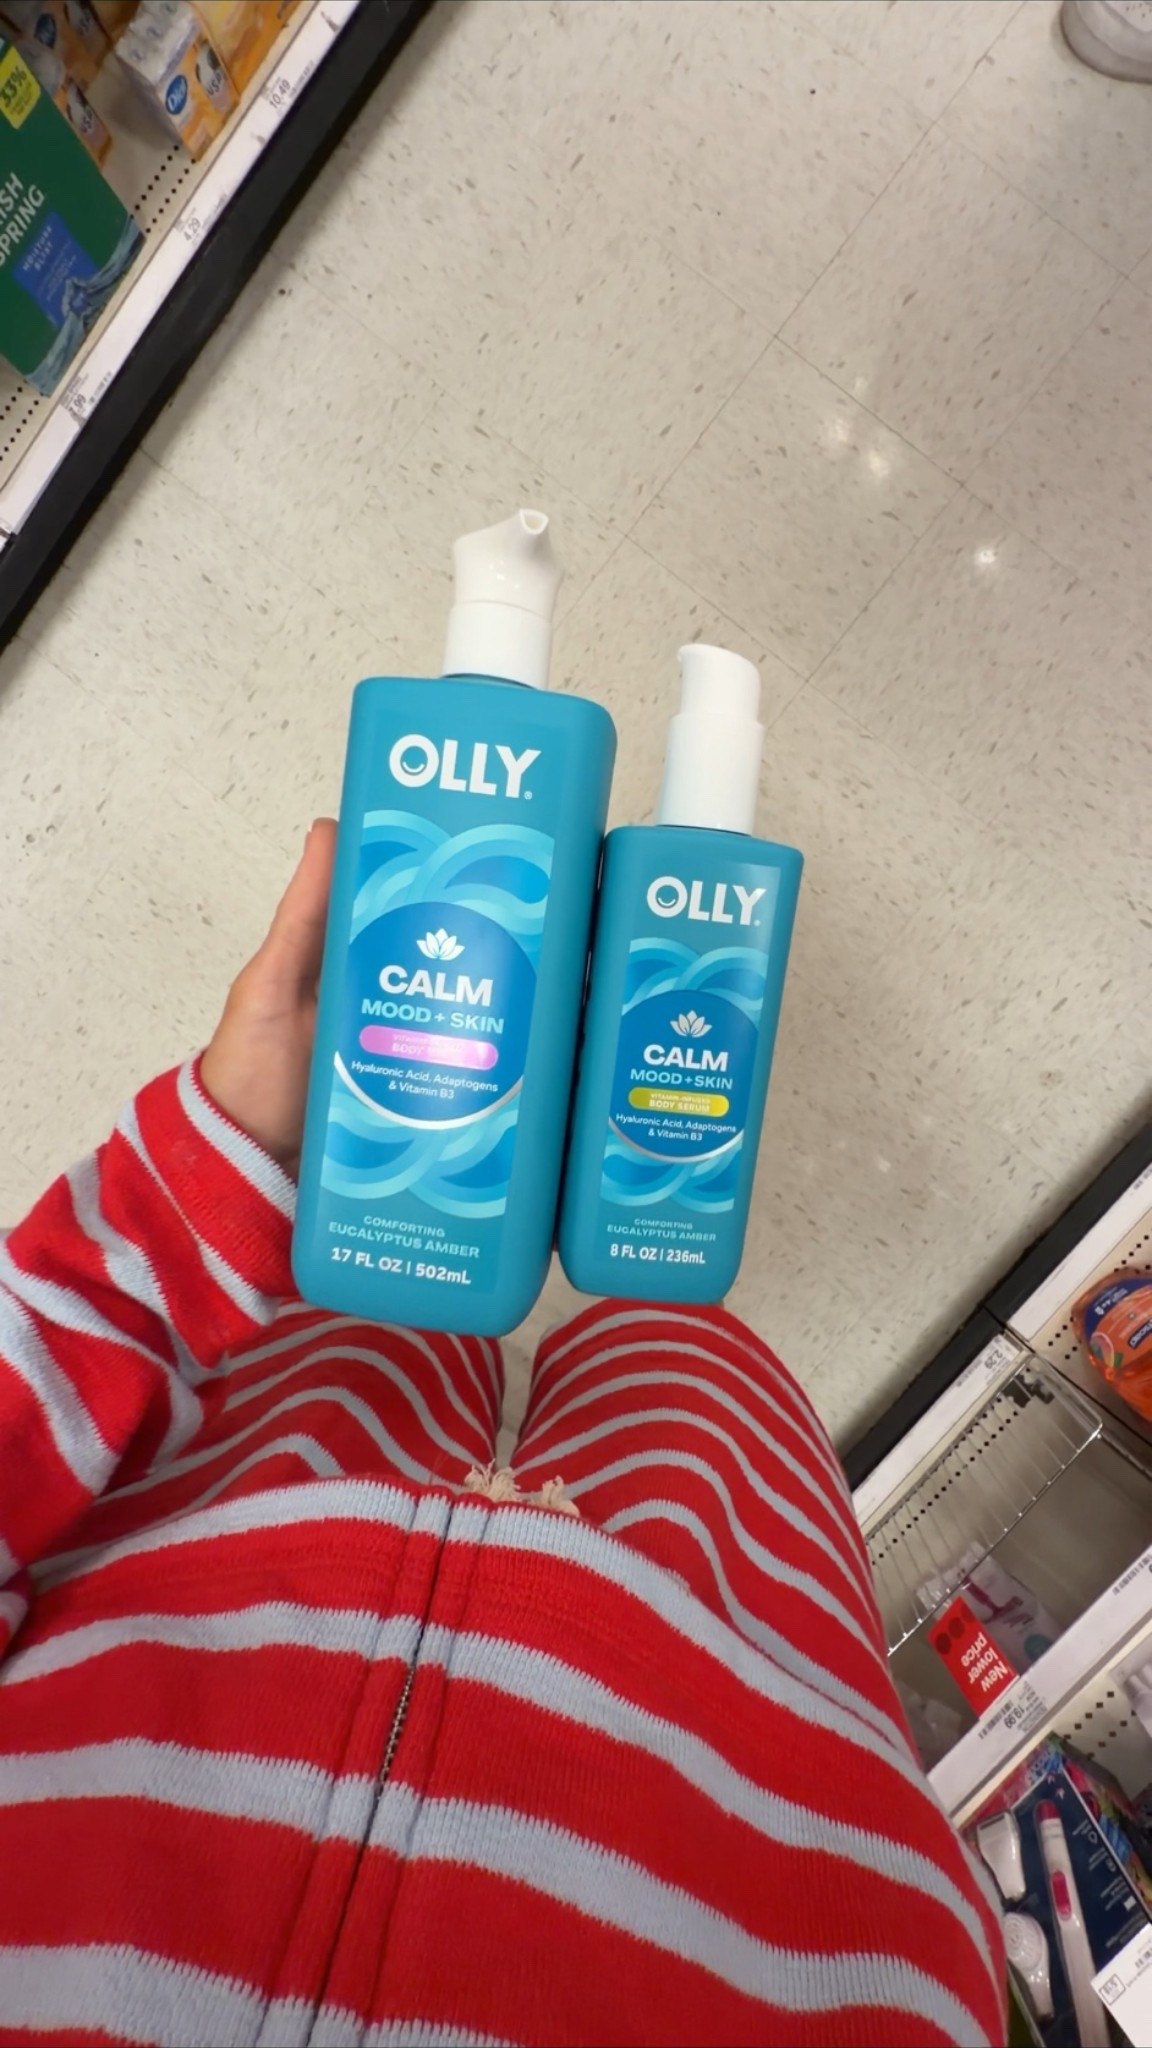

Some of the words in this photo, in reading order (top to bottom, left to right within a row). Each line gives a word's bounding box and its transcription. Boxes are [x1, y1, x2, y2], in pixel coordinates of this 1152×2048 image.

[207, 71, 222, 96] USA
[269, 79, 291, 109] 10.49
[0, 172, 23, 224] ISH
[184, 217, 201, 241] 4.29
[389, 734, 542, 799] OLLY
[647, 875, 767, 926] OLLY
[378, 964, 494, 1008] CALM
[361, 998, 432, 1024] MOOD
[434, 1012, 446, 1023] +
[450, 1012, 505, 1034] SKIN
[393, 1042, 424, 1056] BODY
[643, 1044, 729, 1072] CALM
[351, 1060, 404, 1079] Hyaluronic
[405, 1069, 432, 1083] Acid,
[433, 1073, 499, 1092] Adaptogens
[630, 1068, 682, 1084] MOOD
[684, 1076, 693, 1084] +
[694, 1075, 733, 1090] SKIN
[388, 1080, 397, 1090] &
[400, 1082, 438, 1097] Vitamin
[439, 1088, 455, 1100] B3
[649, 1099, 675, 1109] BODY
[677, 1101, 710, 1112] SERUM
[615, 1113, 660, 1126] Hyaluronic
[662, 1117, 684, 1129] Acid,
[685, 1120, 737, 1134] Adaptogens
[648, 1128, 655, 1136] &
[657, 1128, 689, 1140] Vitamin
[690, 1132, 703, 1142] B3
[364, 1215, 446, 1238] COMFORTING
[607, 1224, 677, 1240] EUCALYPTUS
[678, 1232, 717, 1242] AMBER
[634, 1218, 694, 1231] COMFORTING
[328, 1221, 422, 1250] EUCALYPTUS
[424, 1239, 480, 1259] AMBER
[331, 1247, 351, 1262] 17
[355, 1251, 375, 1268] FL
[378, 1256, 403, 1273] OZ
[415, 1262, 472, 1285] 502mL
[610, 1243, 619, 1257] 8
[621, 1244, 636, 1259] FL
[639, 1246, 658, 1261] OZ
[666, 1248, 706, 1265] 236mL
[984, 1349, 1003, 1369] 2.29
[960, 1631, 988, 1667] price
[967, 1646, 999, 1685] lower
[980, 1660, 1009, 1693] New
[1003, 1704, 1025, 1729] 19.99
